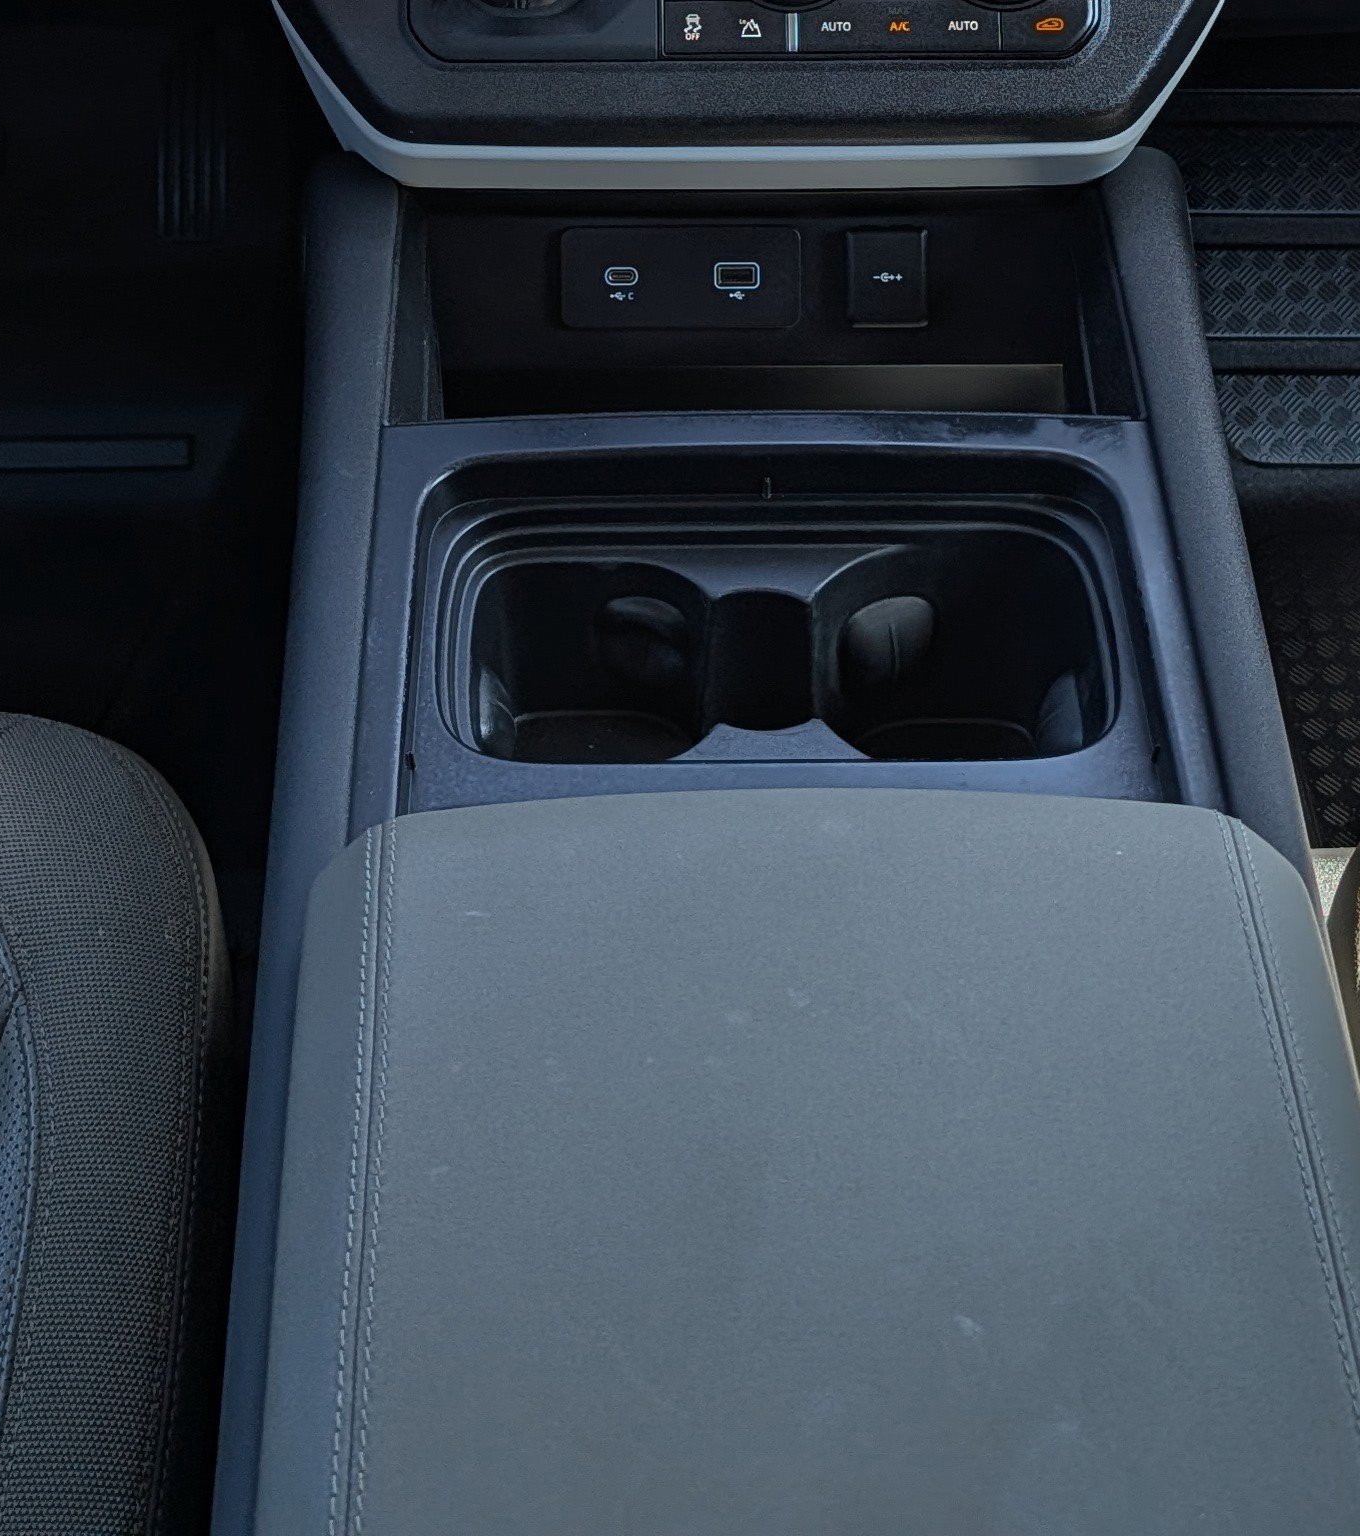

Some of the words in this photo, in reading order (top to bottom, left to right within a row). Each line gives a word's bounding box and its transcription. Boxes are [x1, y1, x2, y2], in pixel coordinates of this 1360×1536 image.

[821, 21, 851, 31] AUTO
[890, 21, 910, 32] A/C
[948, 20, 979, 31] AUTO
